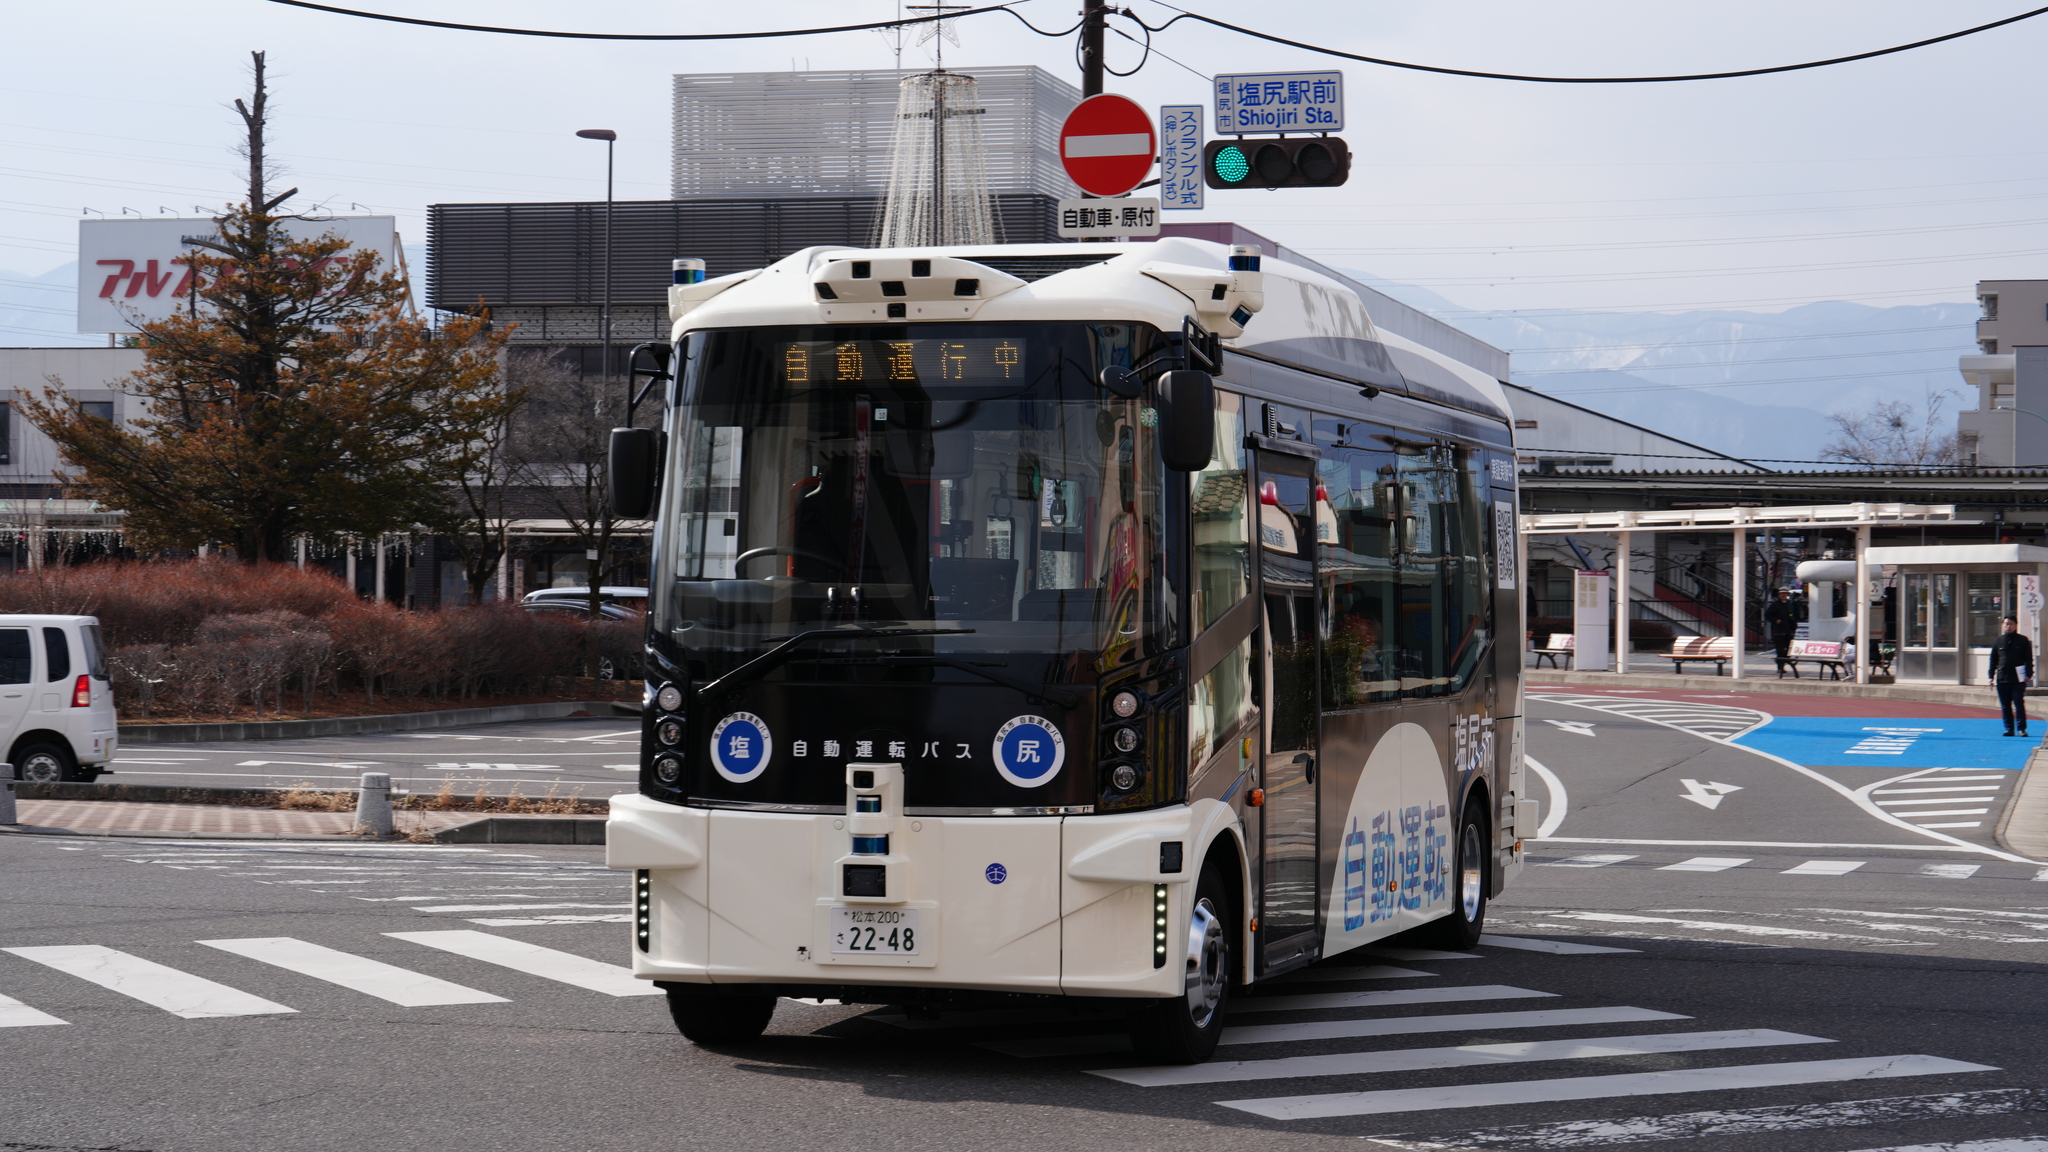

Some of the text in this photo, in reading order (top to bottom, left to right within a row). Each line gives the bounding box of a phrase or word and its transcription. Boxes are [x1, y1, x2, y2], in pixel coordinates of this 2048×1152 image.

[1217, 81, 1232, 128] 塩尻市
[1236, 79, 1337, 106] 塩尻駅前
[1238, 105, 1339, 128] Shiojiri Sta.
[1180, 111, 1198, 205] スクランブル式
[1063, 207, 1155, 229] 自動車・原付
[786, 341, 1018, 381] 自動運行中
[1019, 716, 1062, 745] 自動運転バス
[1455, 711, 1493, 771] 塩尻市
[729, 736, 750, 758] 塩
[793, 739, 972, 760] 自動運転バス
[1016, 740, 1040, 763] 尻
[1343, 800, 1447, 932] 自動運転
[836, 926, 915, 951] さ 22-48
